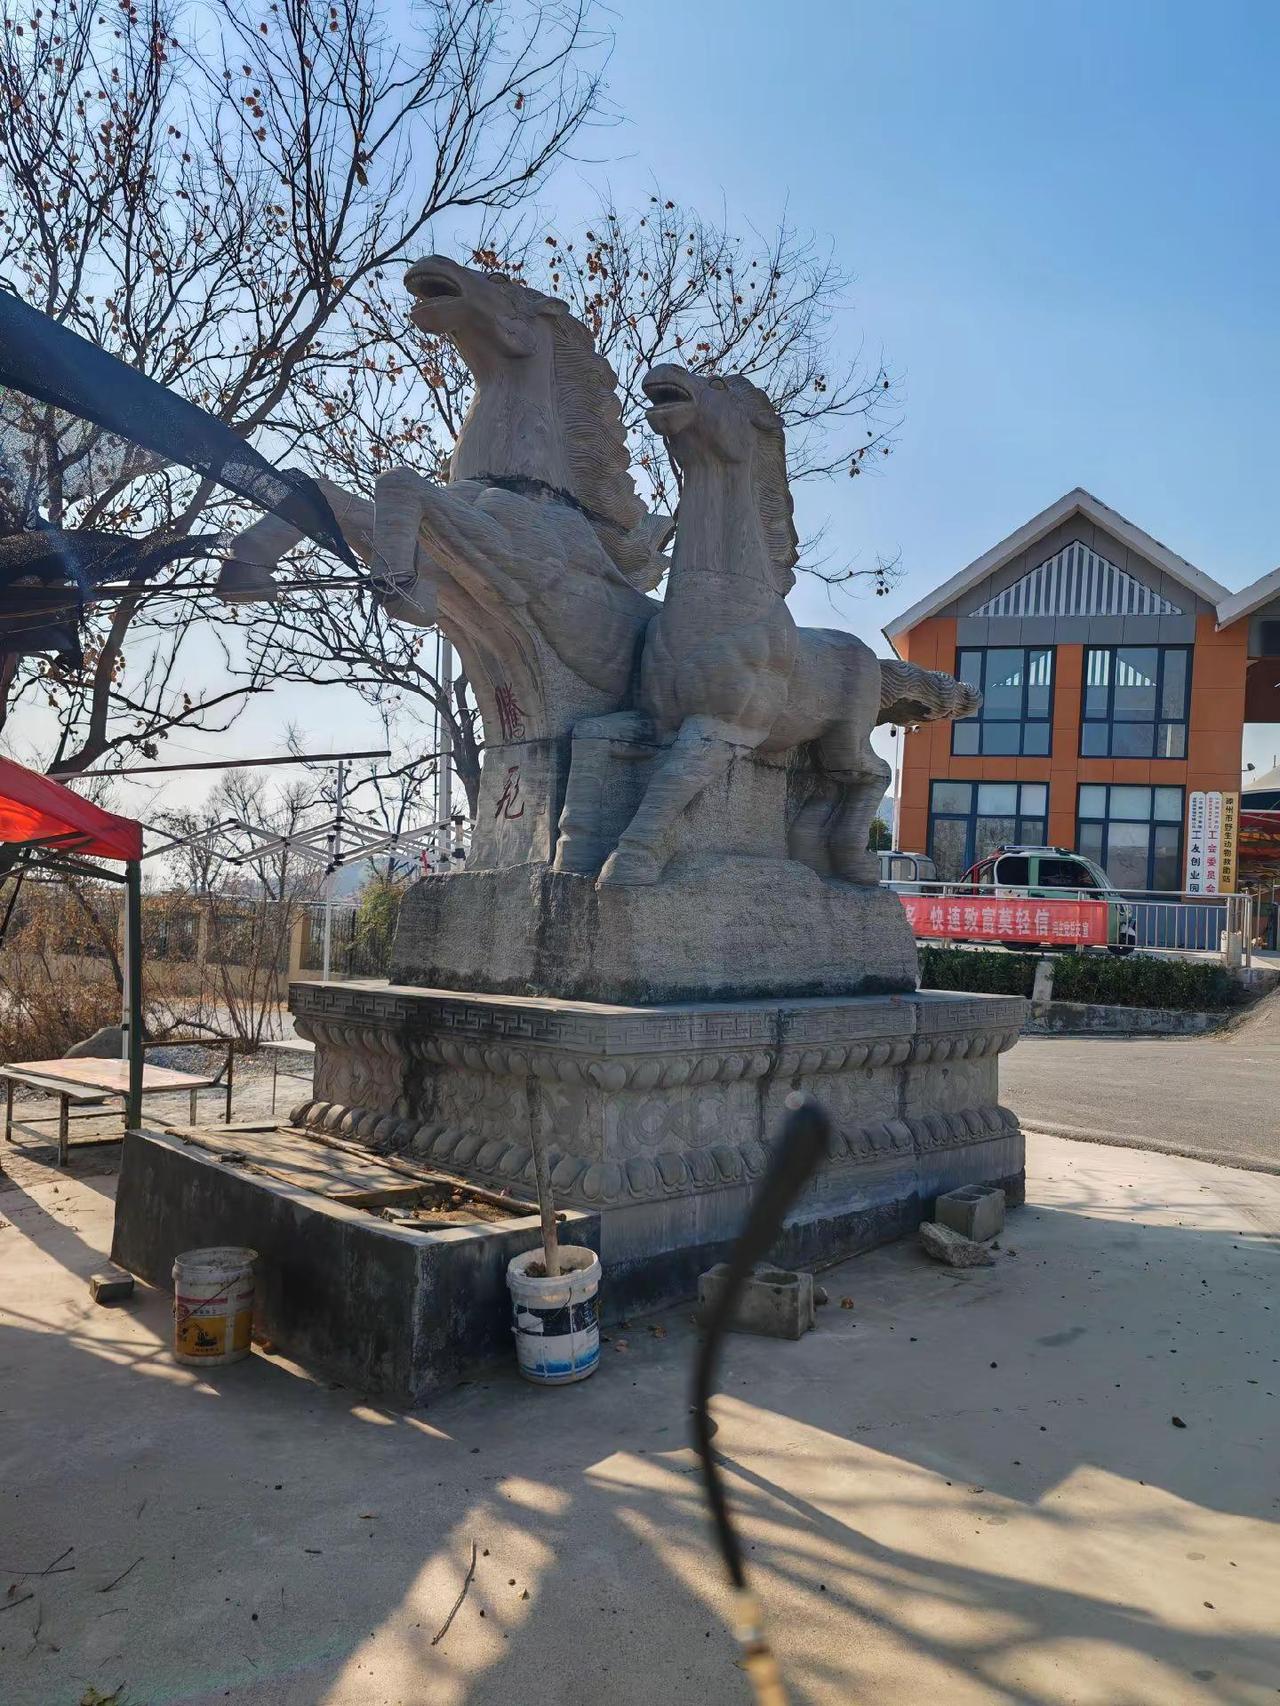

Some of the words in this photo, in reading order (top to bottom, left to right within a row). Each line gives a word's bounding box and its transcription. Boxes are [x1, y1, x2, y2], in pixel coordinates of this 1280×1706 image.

[1189, 830, 1202, 893] 工友创业园
[1205, 830, 1218, 893] 工会委员会
[929, 905, 1051, 936] 快速致富莫轻信
